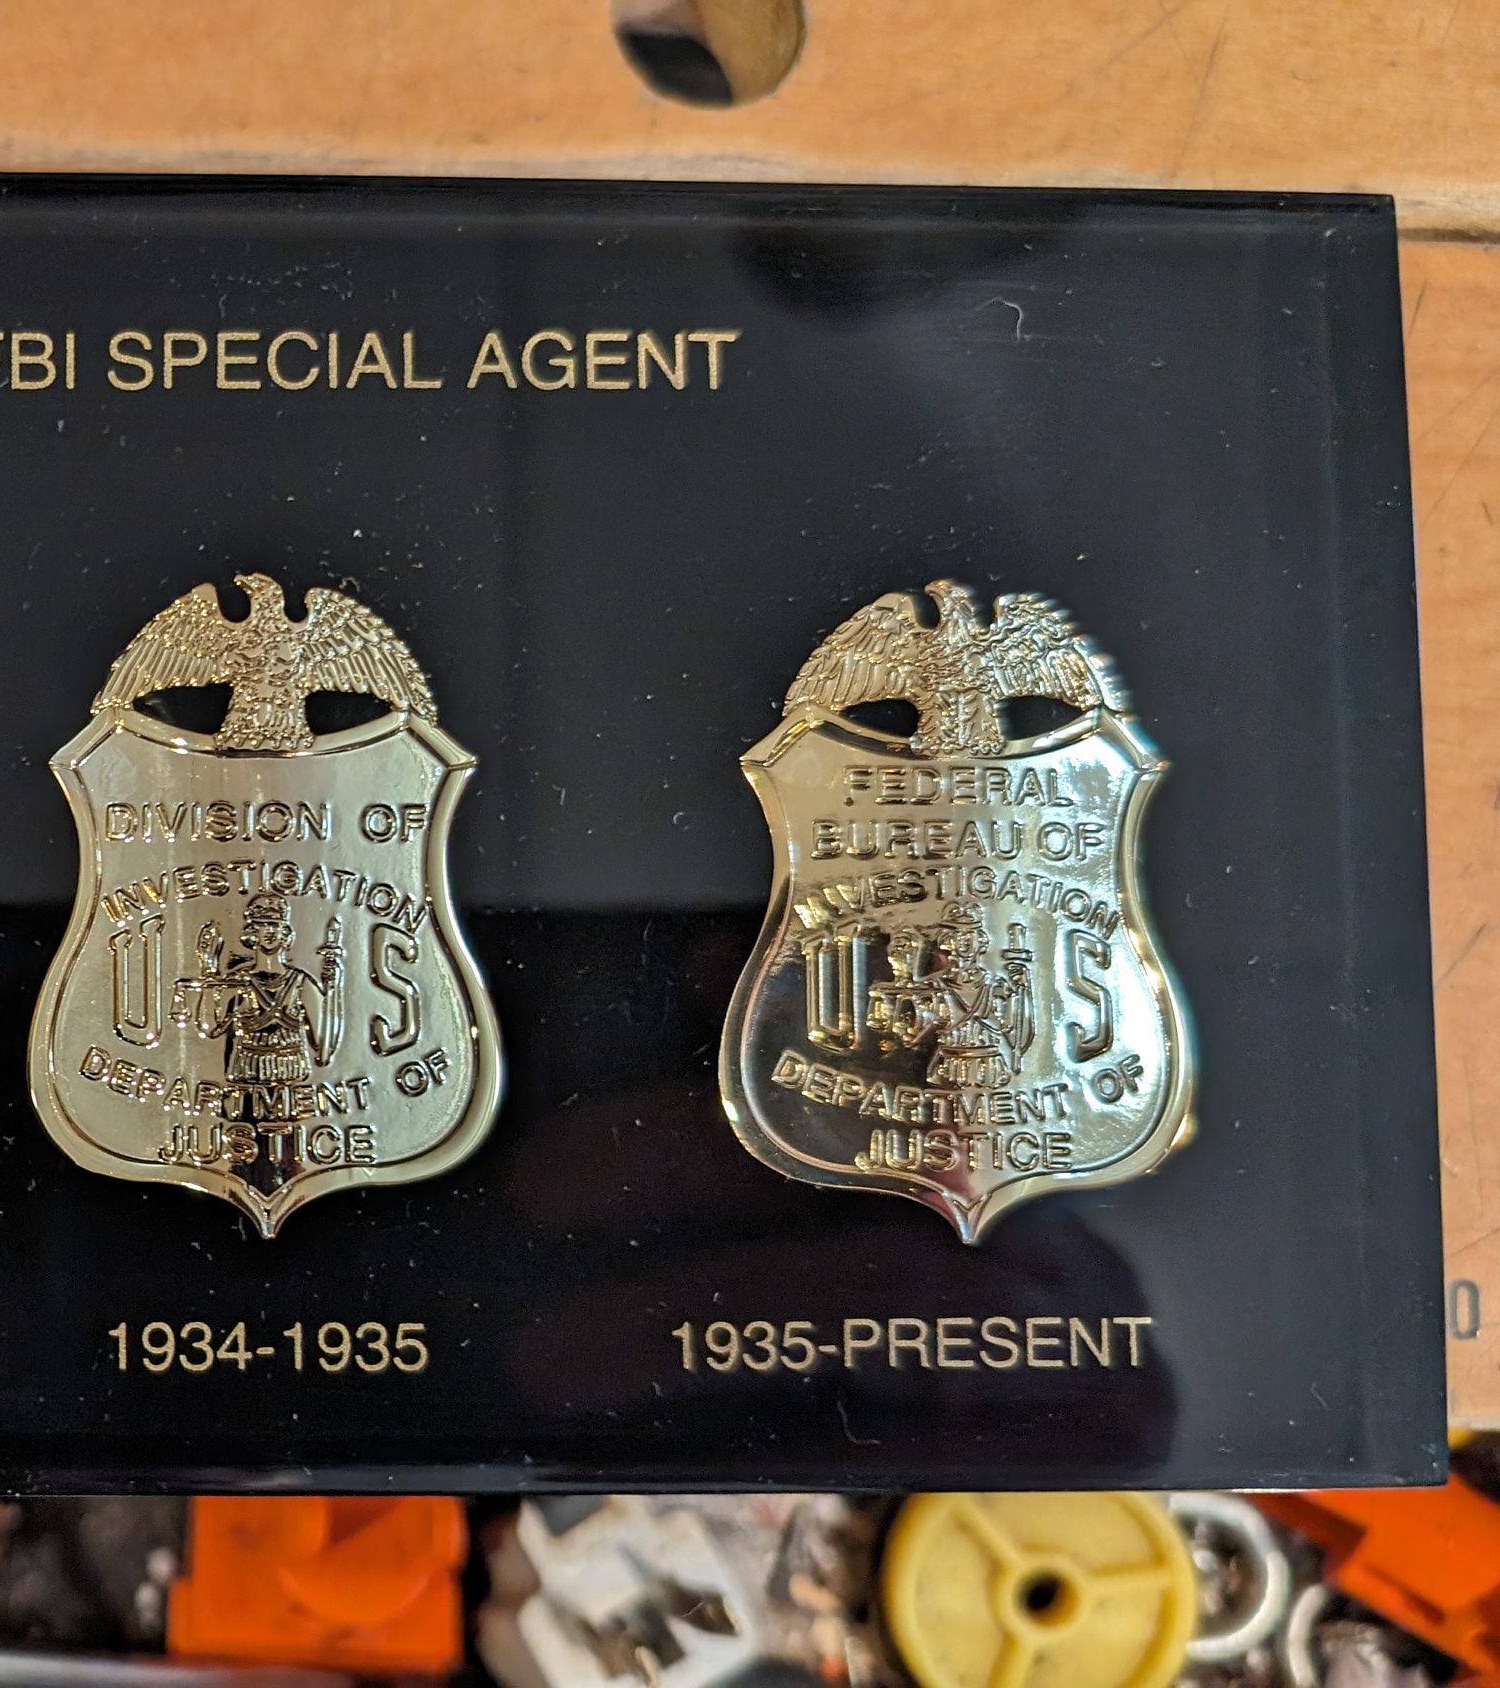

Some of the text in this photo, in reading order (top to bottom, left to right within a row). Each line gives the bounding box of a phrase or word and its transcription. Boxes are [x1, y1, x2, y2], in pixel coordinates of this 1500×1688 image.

[107, 331, 442, 391] SPECIAL
[467, 330, 738, 391] AGENT
[843, 765, 1075, 808] FEDERAL
[104, 800, 428, 843] DIVISION OF
[810, 819, 1106, 862] BUREAU OF
[100, 860, 431, 933] INVESTIGATION
[793, 865, 1120, 938] INVESTIGATION
[77, 1045, 453, 1120] DEPARTMENT OF
[770, 1049, 1145, 1126] DEPARTMENT OF
[157, 1123, 379, 1166] JUSTICE
[854, 1129, 1073, 1172] JUSTICE
[109, 1320, 429, 1374] 1934-1935
[670, 1316, 1153, 1373] 1935-PRESENT
